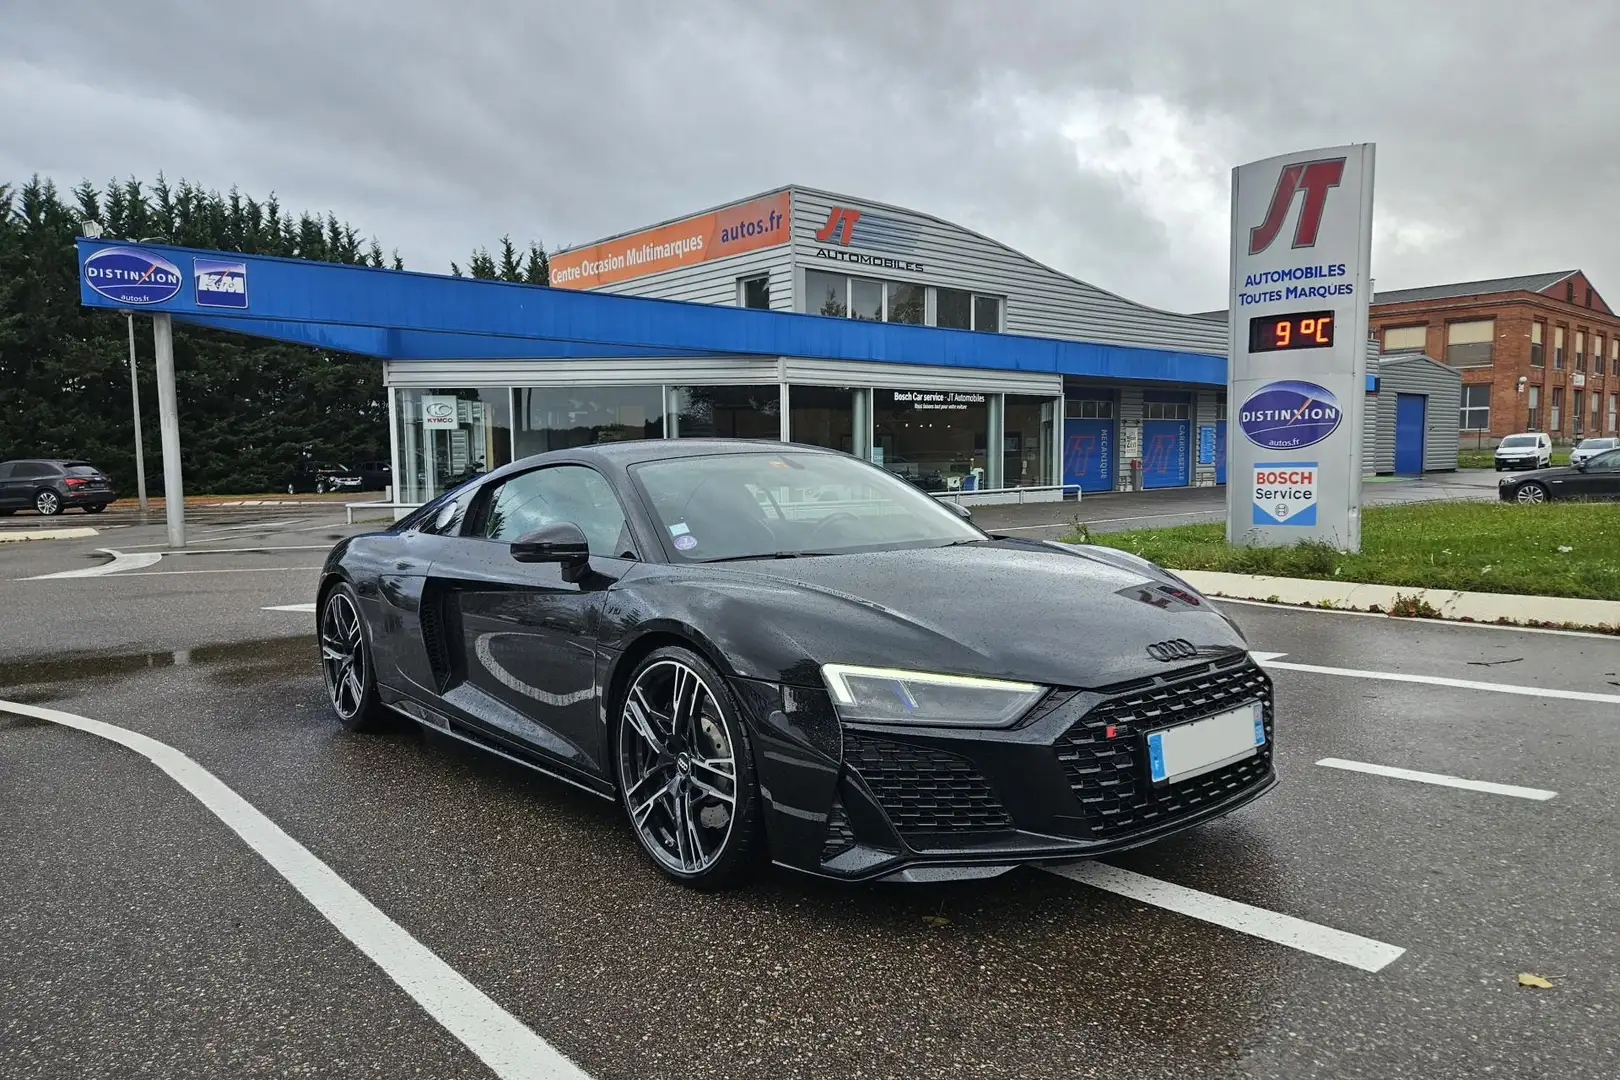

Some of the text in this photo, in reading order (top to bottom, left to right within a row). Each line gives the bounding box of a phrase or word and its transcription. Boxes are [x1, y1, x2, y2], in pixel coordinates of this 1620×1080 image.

[1248, 157, 1347, 256] JT
[721, 210, 783, 243] autos.fr
[815, 206, 862, 247] JT
[551, 234, 703, 285] Centre Occasion Multimarques
[816, 248, 924, 272] AUTOMOBILES
[88, 266, 177, 284] DISTINXION
[1245, 264, 1346, 287] AUTOMOBILES
[121, 294, 149, 303] autos.fr
[1239, 284, 1353, 306] TOUTES MARQUES
[1275, 321, 1291, 346] 9
[894, 392, 912, 401] Bosch
[913, 392, 924, 401] Car
[924, 393, 944, 402] service
[947, 393, 954, 402] JT
[954, 393, 985, 403] Automobiles
[1242, 407, 1336, 423] DISTINXION
[1268, 438, 1300, 447] autos.fr
[1100, 429, 1109, 480] MECANIQUE
[1256, 471, 1313, 485] BOSCH
[1255, 487, 1312, 500] Service
